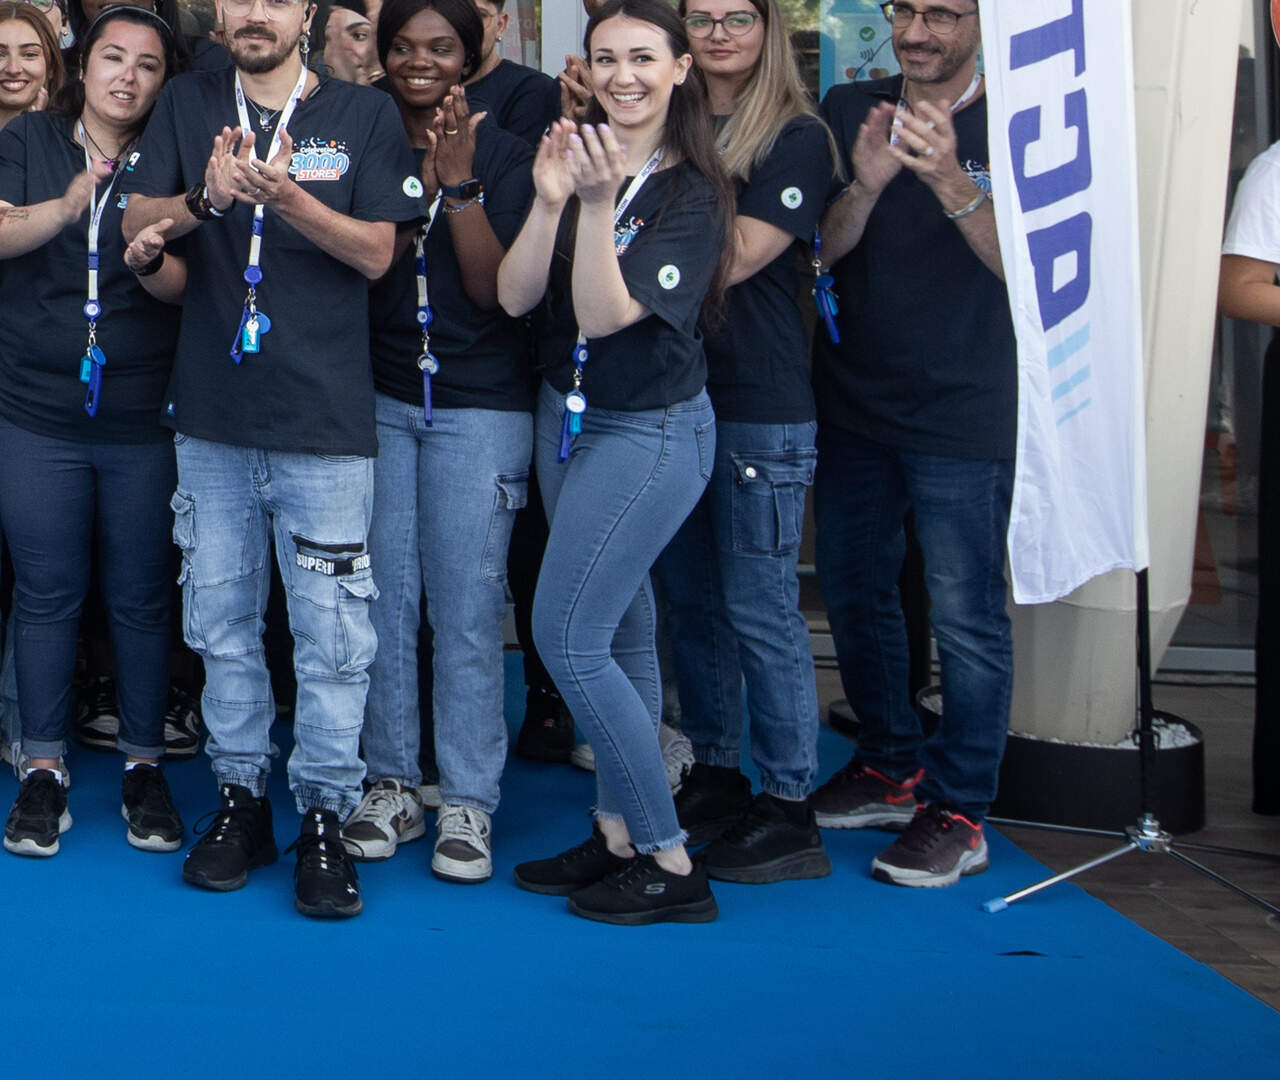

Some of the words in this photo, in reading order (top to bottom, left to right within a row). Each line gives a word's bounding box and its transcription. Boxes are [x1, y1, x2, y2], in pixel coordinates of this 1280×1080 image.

[299, 146, 338, 155] Celebrating
[288, 152, 350, 175] 3000
[298, 169, 338, 180] STORES
